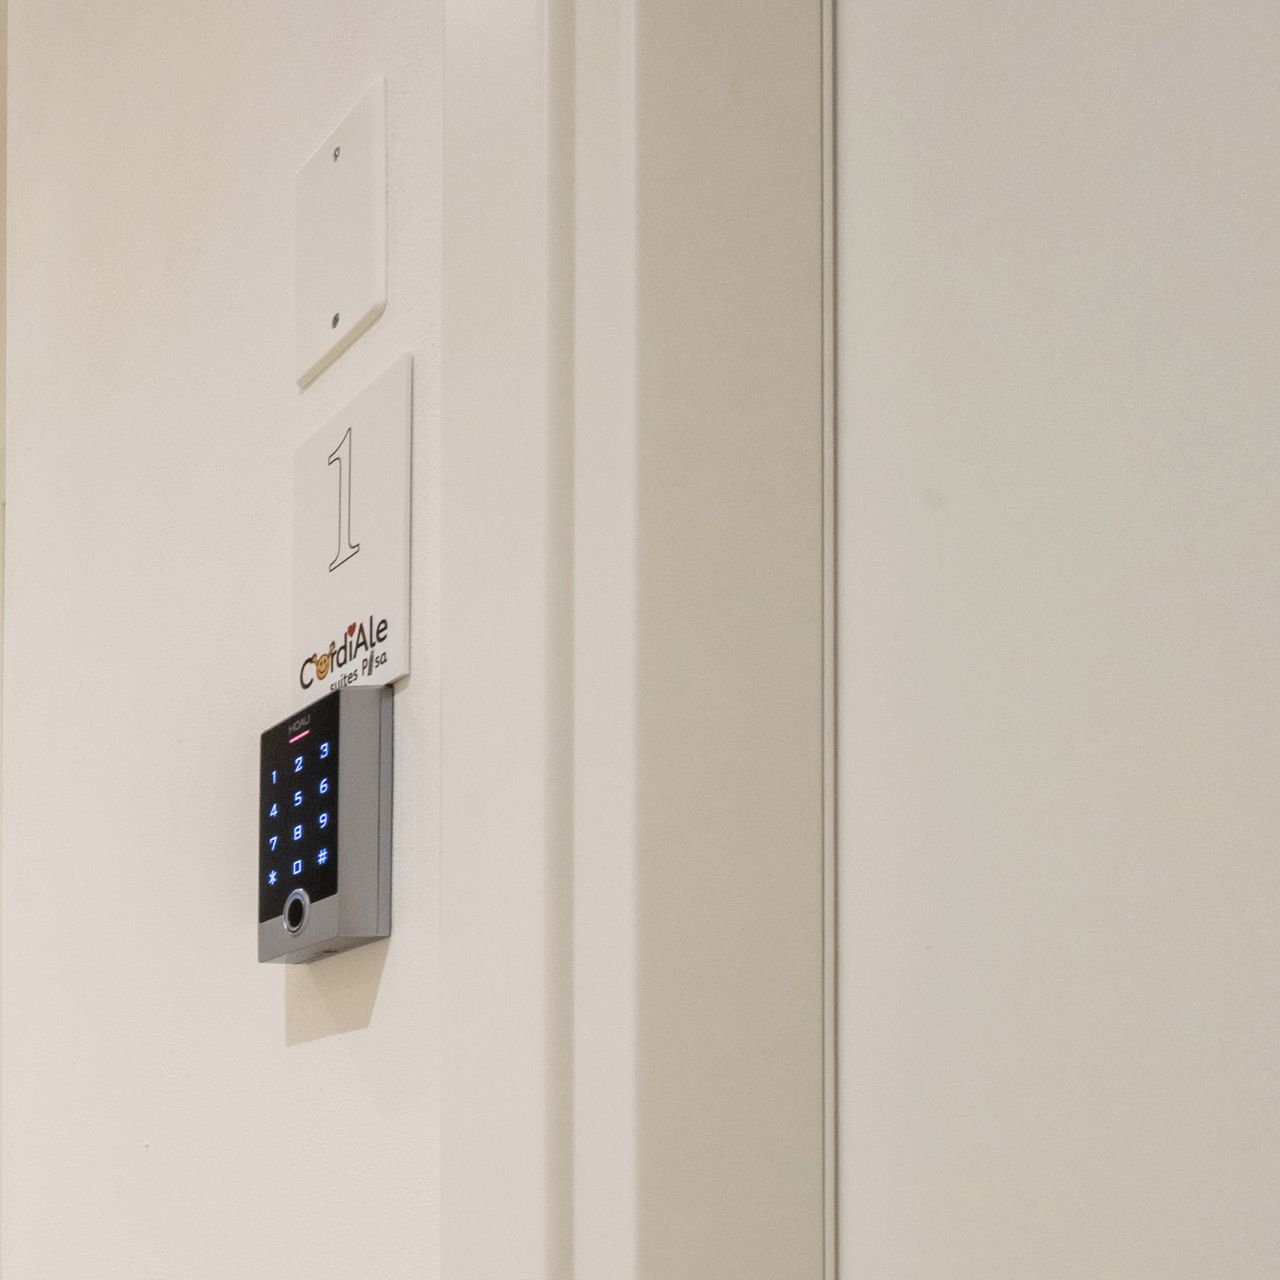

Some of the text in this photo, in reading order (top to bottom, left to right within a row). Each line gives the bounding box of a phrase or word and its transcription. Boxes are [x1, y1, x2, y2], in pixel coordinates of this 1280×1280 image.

[328, 426, 360, 573] 1
[329, 669, 358, 690] suites
[271, 742, 329, 784] 1 2 3
[269, 778, 328, 817] 4 5 6
[269, 812, 328, 851] 7 8 9
[293, 859, 303, 875] 0
